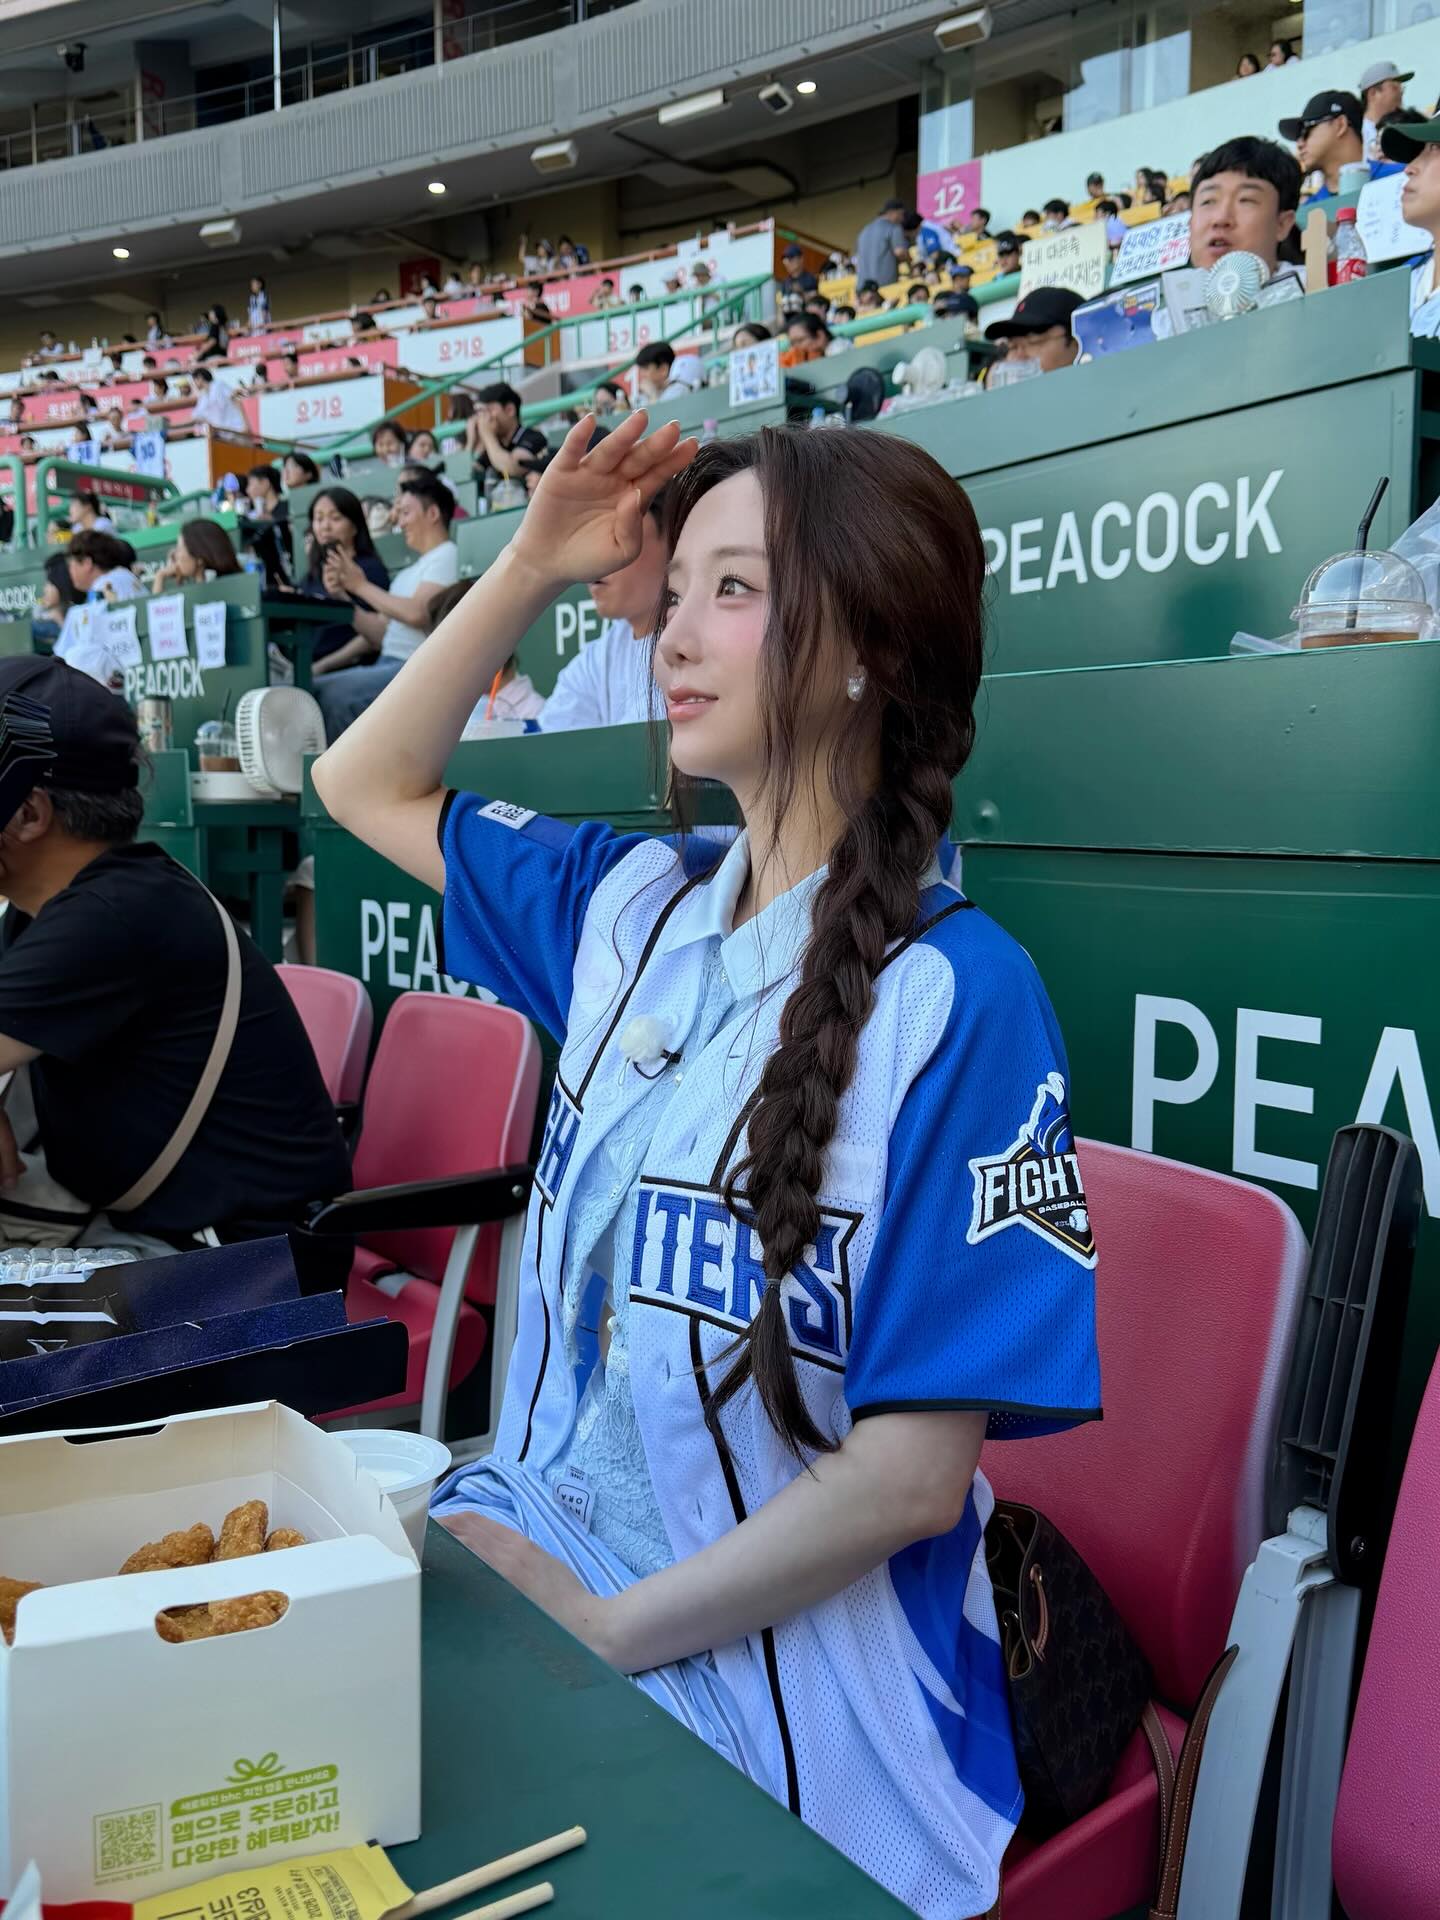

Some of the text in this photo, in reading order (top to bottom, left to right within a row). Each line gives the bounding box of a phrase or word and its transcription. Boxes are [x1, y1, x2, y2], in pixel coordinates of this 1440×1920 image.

[933, 182, 965, 217] 12
[555, 600, 613, 655] PE
[124, 658, 205, 703] PEACOCK
[361, 899, 498, 1003] PEA
[1131, 994, 1440, 1219] PEA
[984, 1153, 1085, 1224] FIGHT
[1038, 1200, 1087, 1214] BASEBALL
[172, 1787, 339, 1844] 앱으로 주문하고
[221, 1791, 242, 1801] bhc
[172, 1811, 341, 1868] 다양한 혜택받자!
